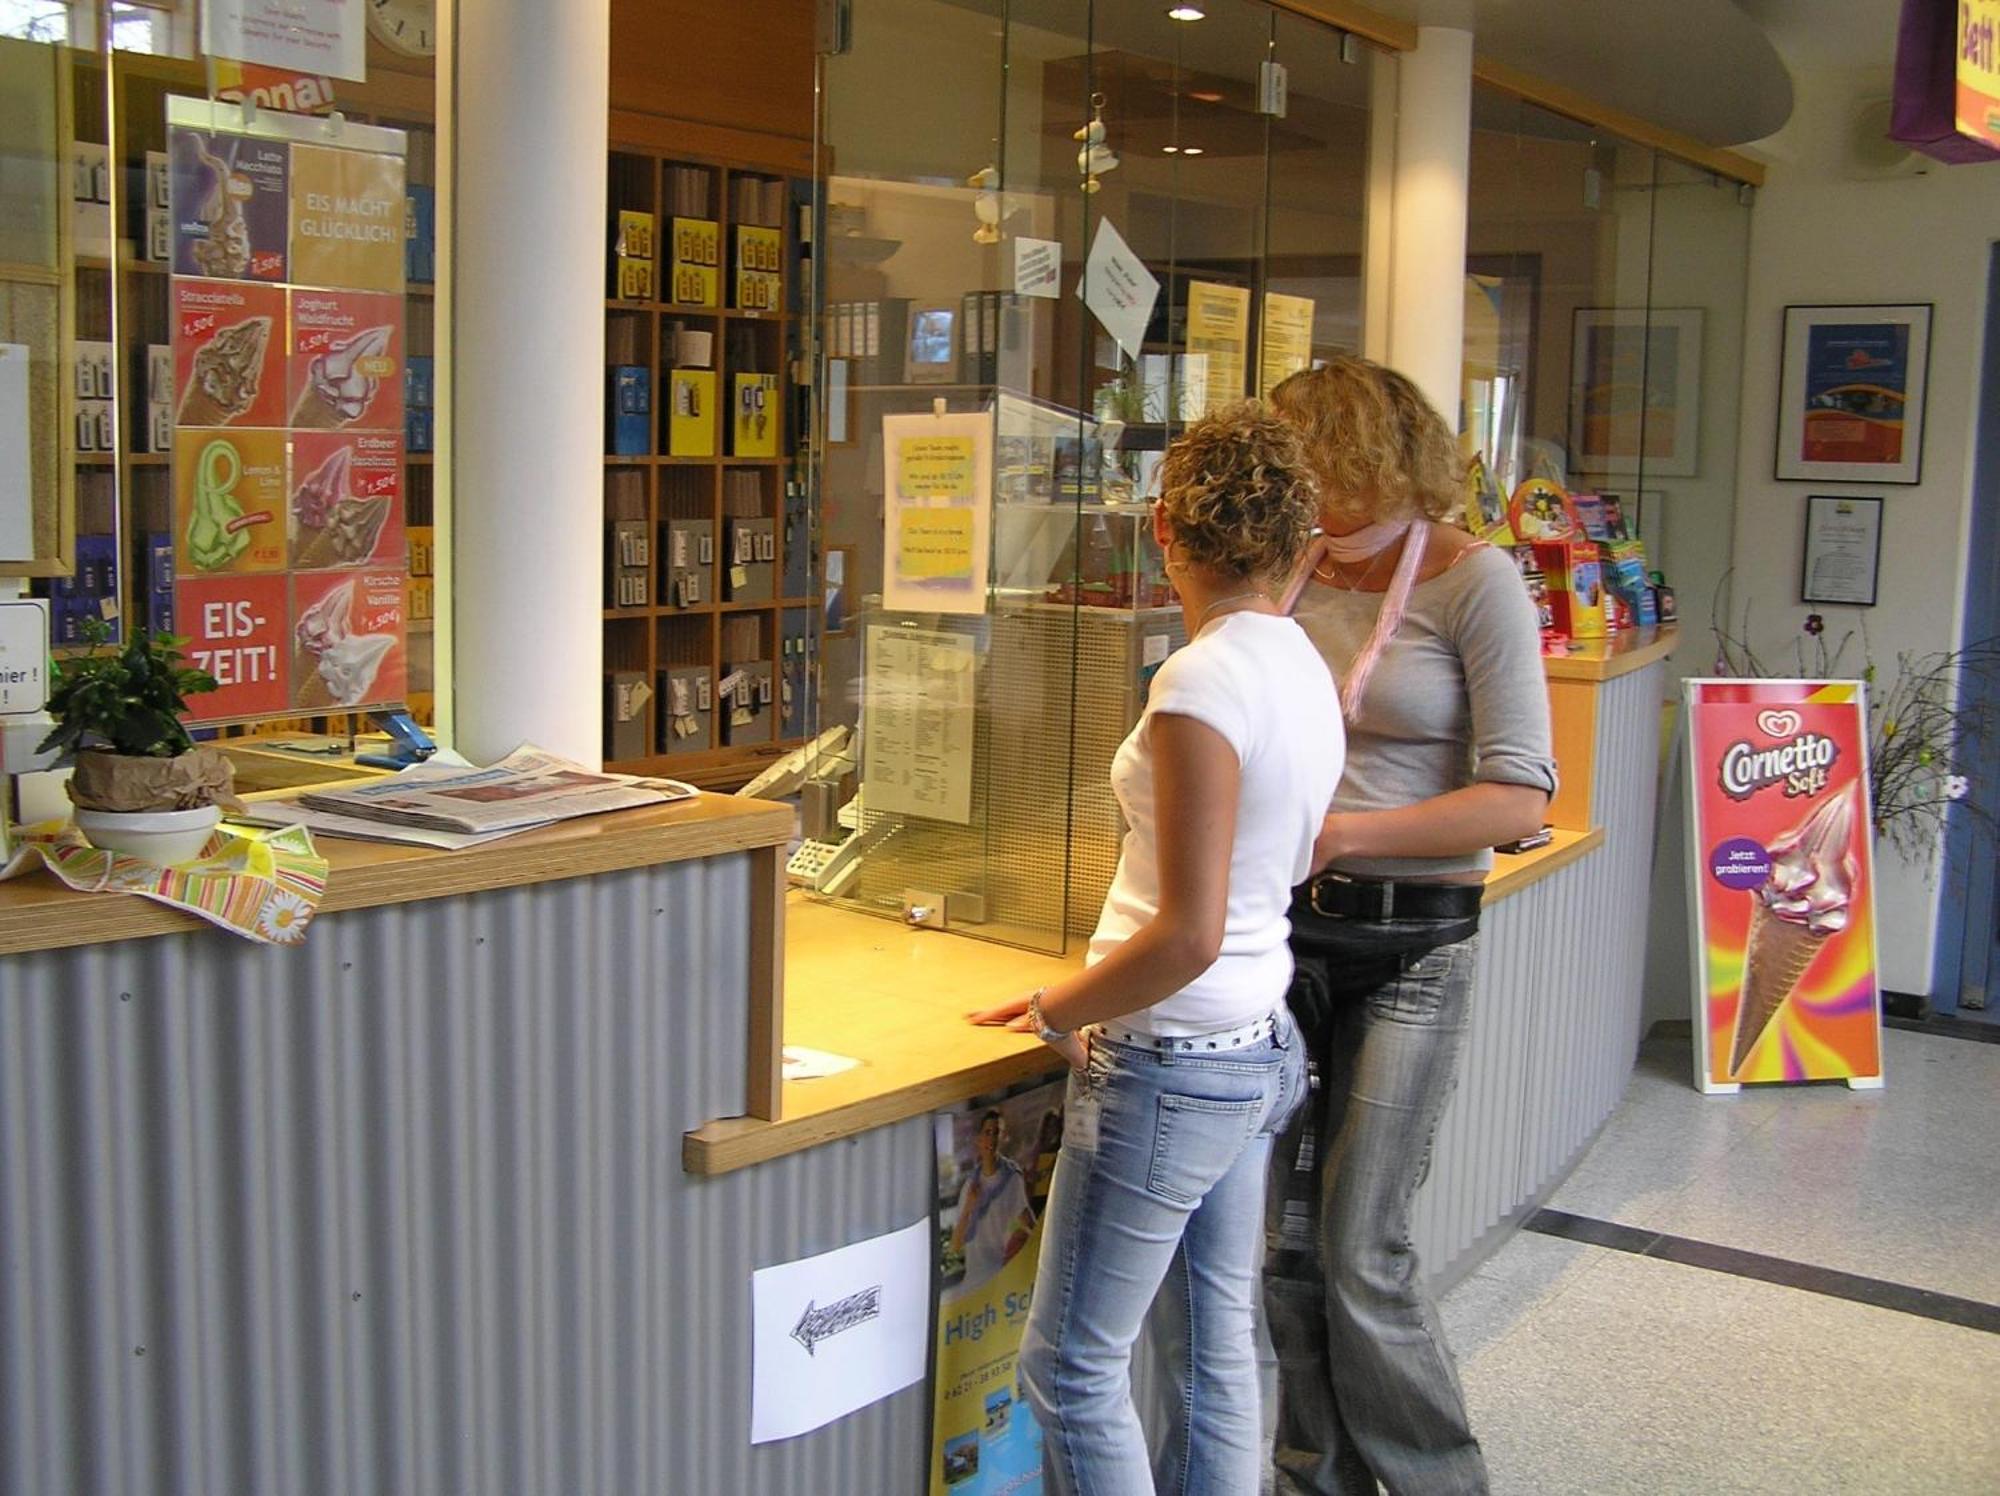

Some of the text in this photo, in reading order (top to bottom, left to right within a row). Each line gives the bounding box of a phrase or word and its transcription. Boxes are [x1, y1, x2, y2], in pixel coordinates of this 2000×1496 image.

[307, 193, 393, 217] EIS MACHT
[301, 217, 396, 243] GLÜCKLICH!
[358, 437, 397, 449] Erdbeer
[367, 594, 400, 605] Vanille
[204, 601, 267, 639] EIS-
[0, 666, 27, 684] ier
[1722, 734, 1834, 793] Cornetto
[1787, 767, 1827, 796] Soft
[1715, 863, 1769, 876] probieren!
[944, 1304, 996, 1346] High
